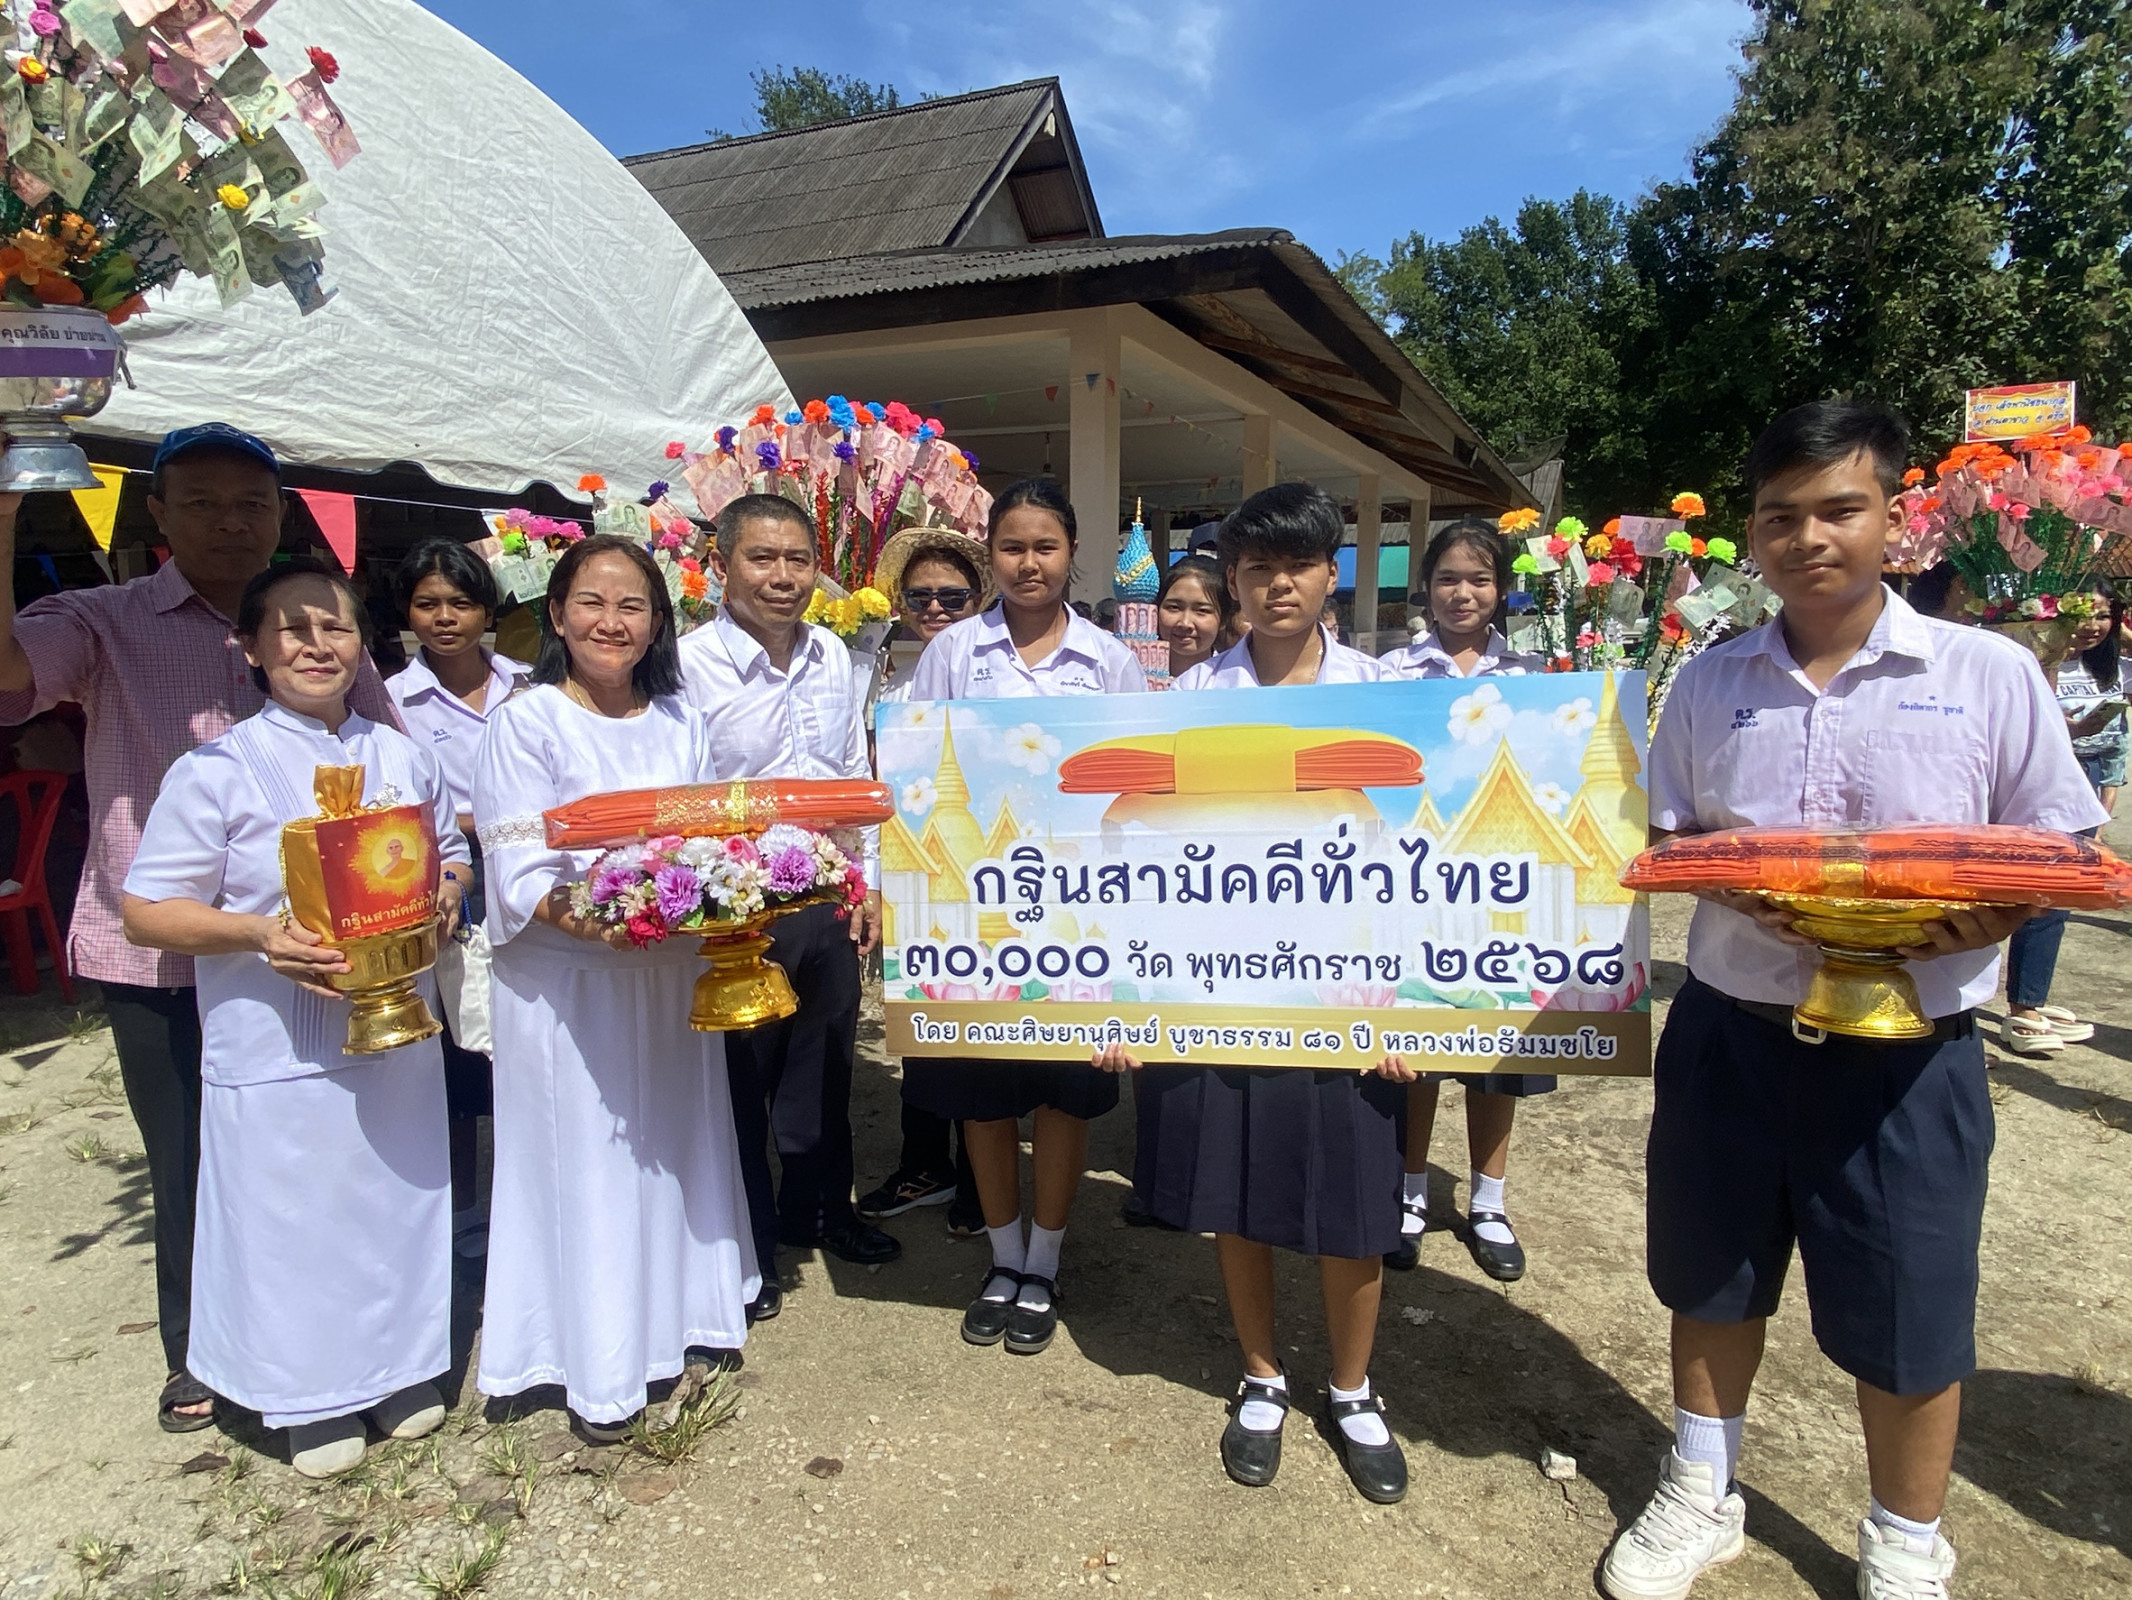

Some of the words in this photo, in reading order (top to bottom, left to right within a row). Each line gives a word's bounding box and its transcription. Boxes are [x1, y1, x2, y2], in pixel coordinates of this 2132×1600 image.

[973, 822, 1530, 923] กฐินสามัคคีทั่วไทย
[906, 944, 1110, 986] ๓๐,๐๐๐
[1127, 939, 1173, 979] วัด
[1186, 940, 1402, 993] พุทธศักราช
[1421, 940, 1624, 986] ๒๕๖๘
[913, 1016, 957, 1041] โดย
[967, 1017, 1159, 1050] คณะศิษยานุศิษย์
[1169, 1025, 1291, 1053] บูชาธรรม
[1303, 1030, 1342, 1049] ๘๑
[1353, 1022, 1372, 1049] ปี
[1383, 1024, 1616, 1057] หลวงพ่อธัมมชโย
